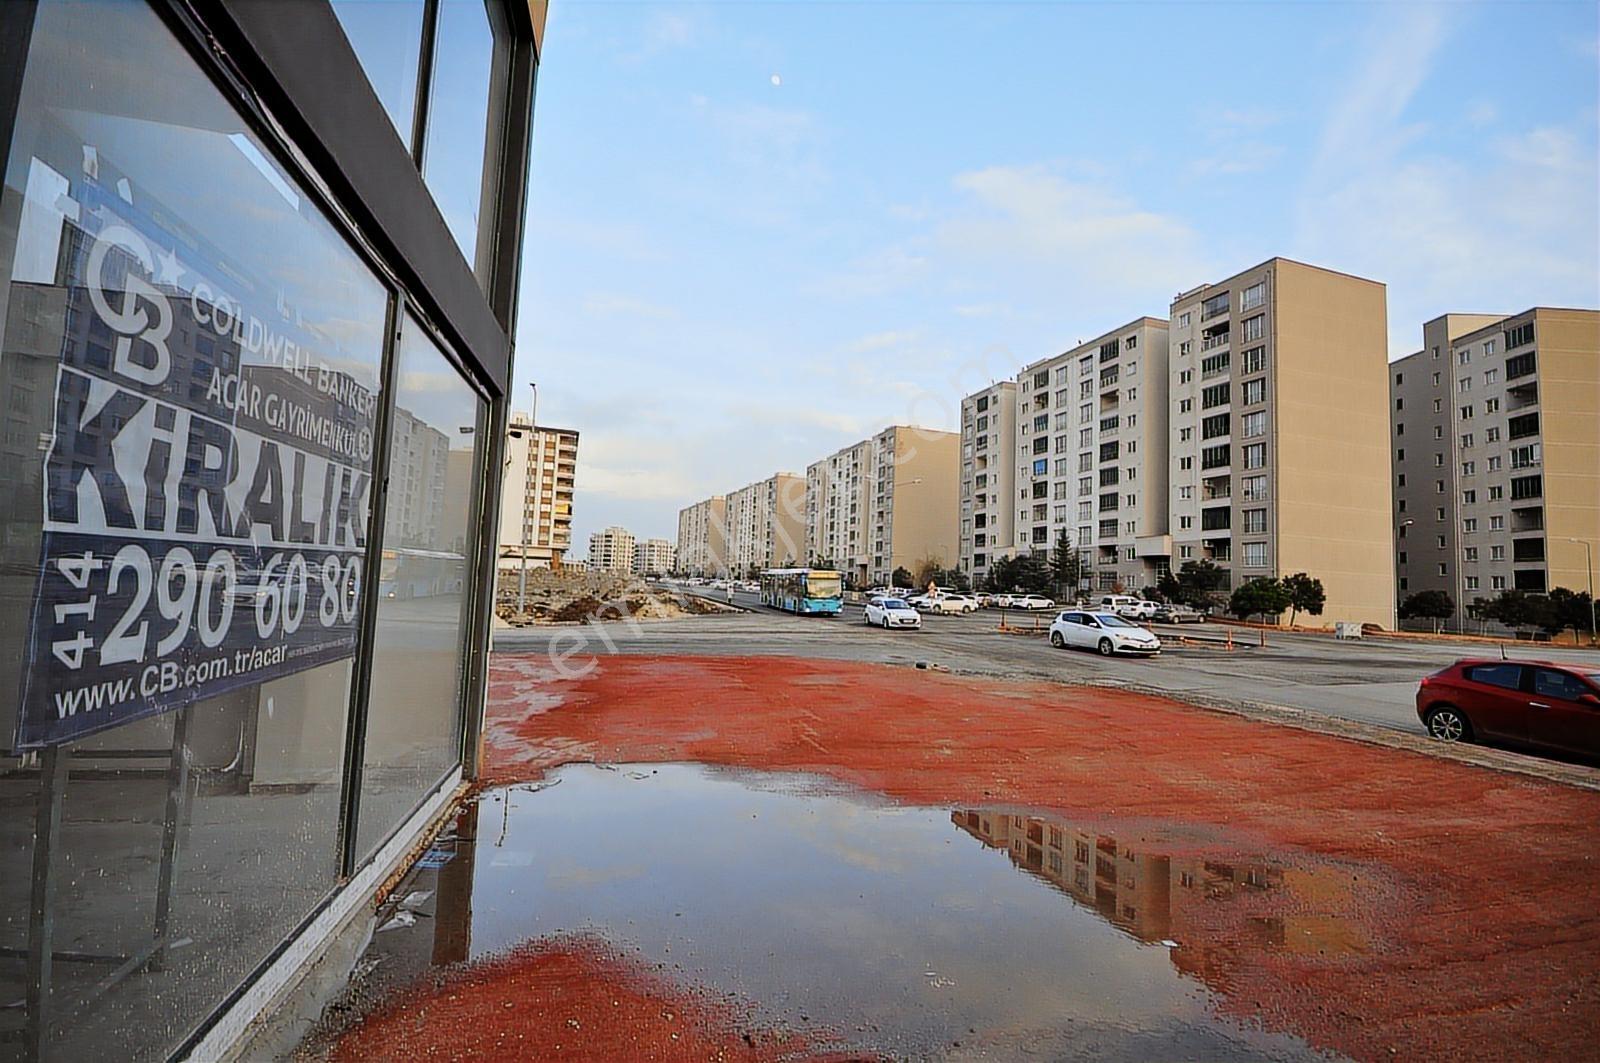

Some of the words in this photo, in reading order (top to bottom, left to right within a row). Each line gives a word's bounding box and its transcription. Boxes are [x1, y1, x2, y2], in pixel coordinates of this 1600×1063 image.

[191, 283, 312, 386] COLDWELL
[317, 362, 375, 420] BANKER
[206, 366, 261, 420] ACAR
[47, 369, 369, 547] KİRALIK
[52, 551, 103, 669] 414
[100, 544, 236, 666] 290
[255, 552, 307, 639] 60
[320, 554, 361, 628] 80
[55, 644, 288, 719] www.CB.com.tr/acar
